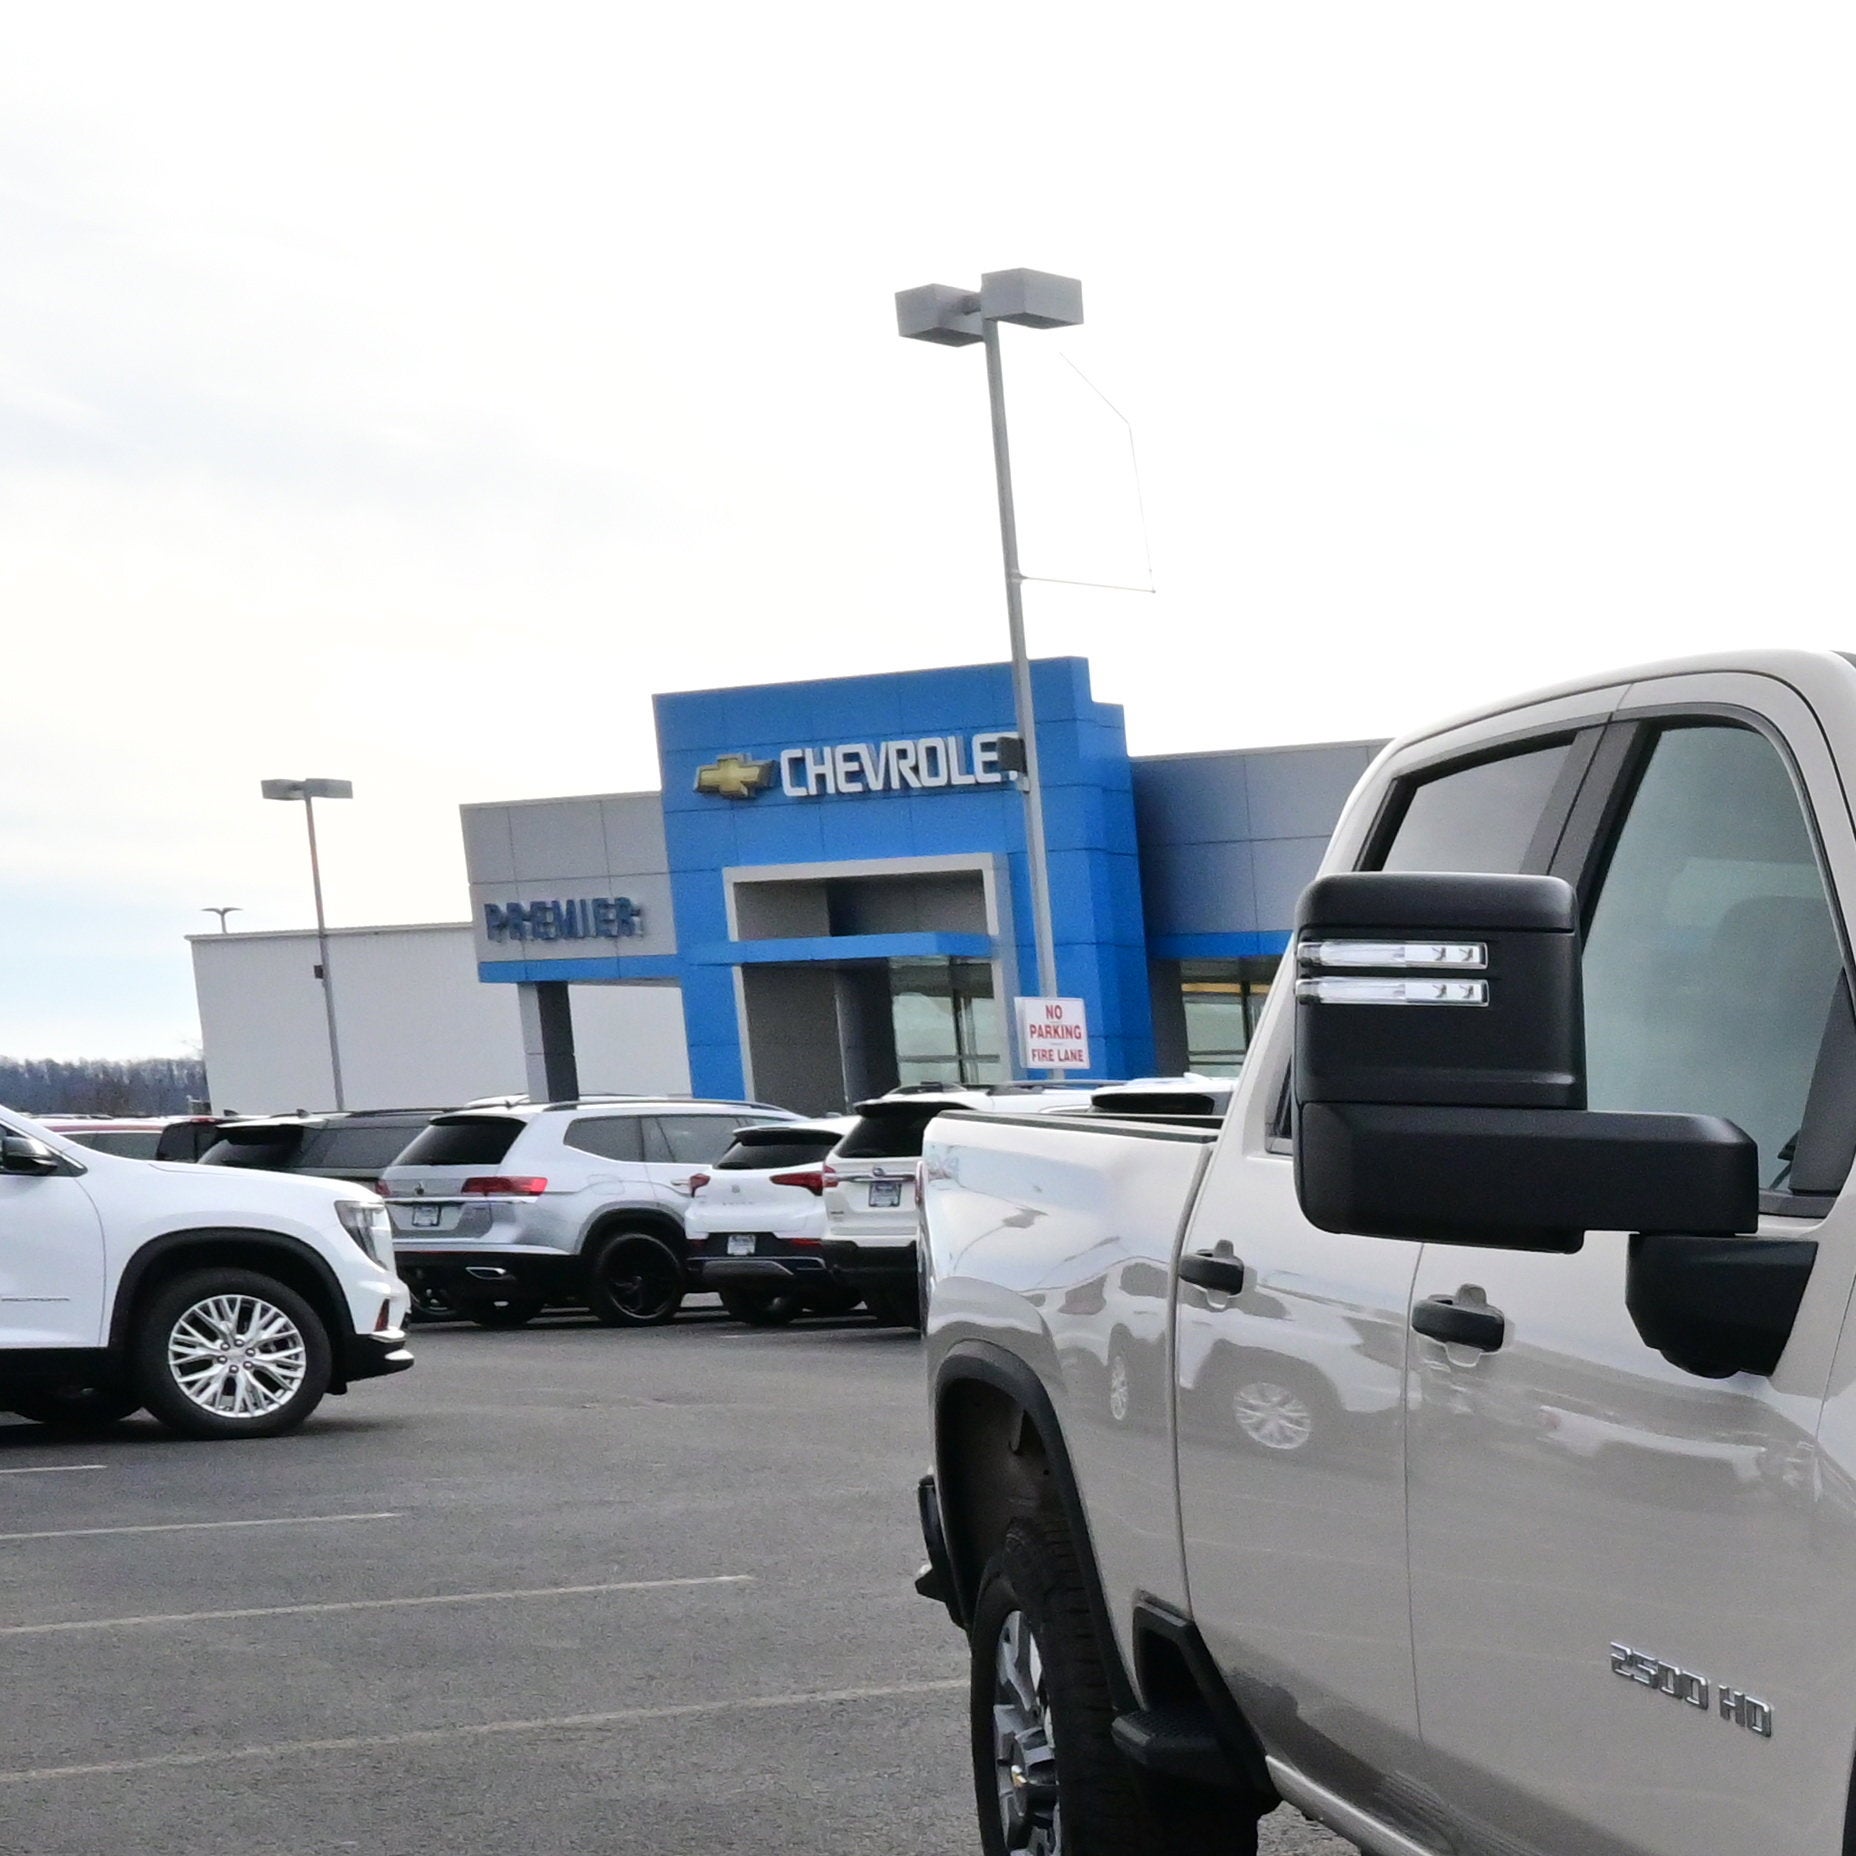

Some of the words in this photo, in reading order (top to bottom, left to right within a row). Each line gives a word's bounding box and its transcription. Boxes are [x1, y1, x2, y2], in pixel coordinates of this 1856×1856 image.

[484, 897, 642, 942] PREMIER
[1045, 1004, 1063, 1020] NO
[1029, 1024, 1083, 1040] PARKING
[1031, 1048, 1055, 1062] FIRE
[1057, 1049, 1084, 1062] LANE
[1610, 1641, 1709, 1711] 2500
[1718, 1684, 1773, 1739] HD
